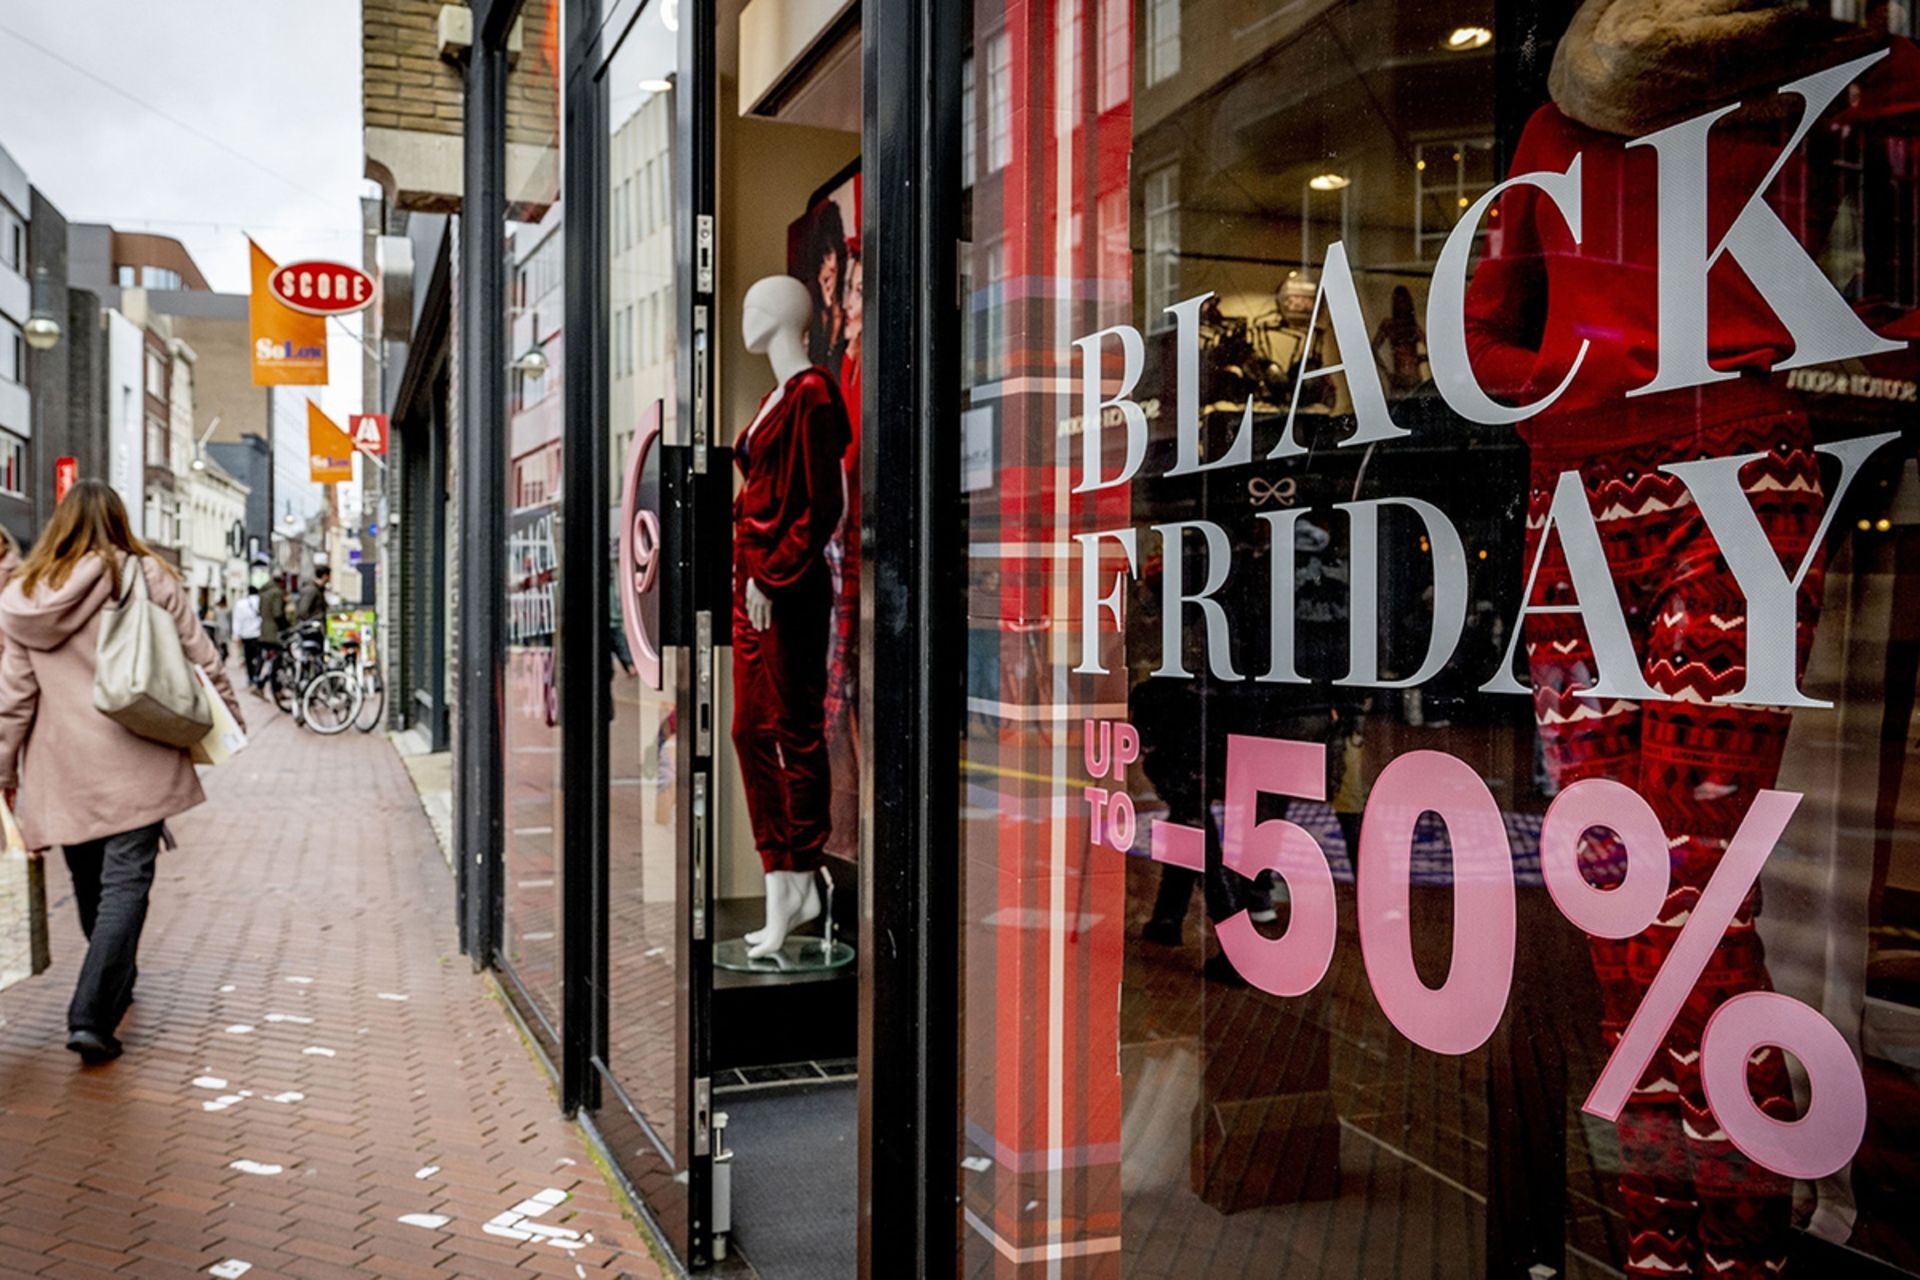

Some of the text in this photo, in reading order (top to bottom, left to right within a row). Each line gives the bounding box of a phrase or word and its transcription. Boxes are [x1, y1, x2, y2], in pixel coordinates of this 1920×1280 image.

[281, 270, 365, 302] SCORE
[1071, 48, 1908, 494] BLACK
[1072, 431, 1901, 708] FRIDAY
[1084, 719, 1140, 782] UP
[1084, 786, 1137, 853] TO
[1151, 733, 1868, 1180] -50%
